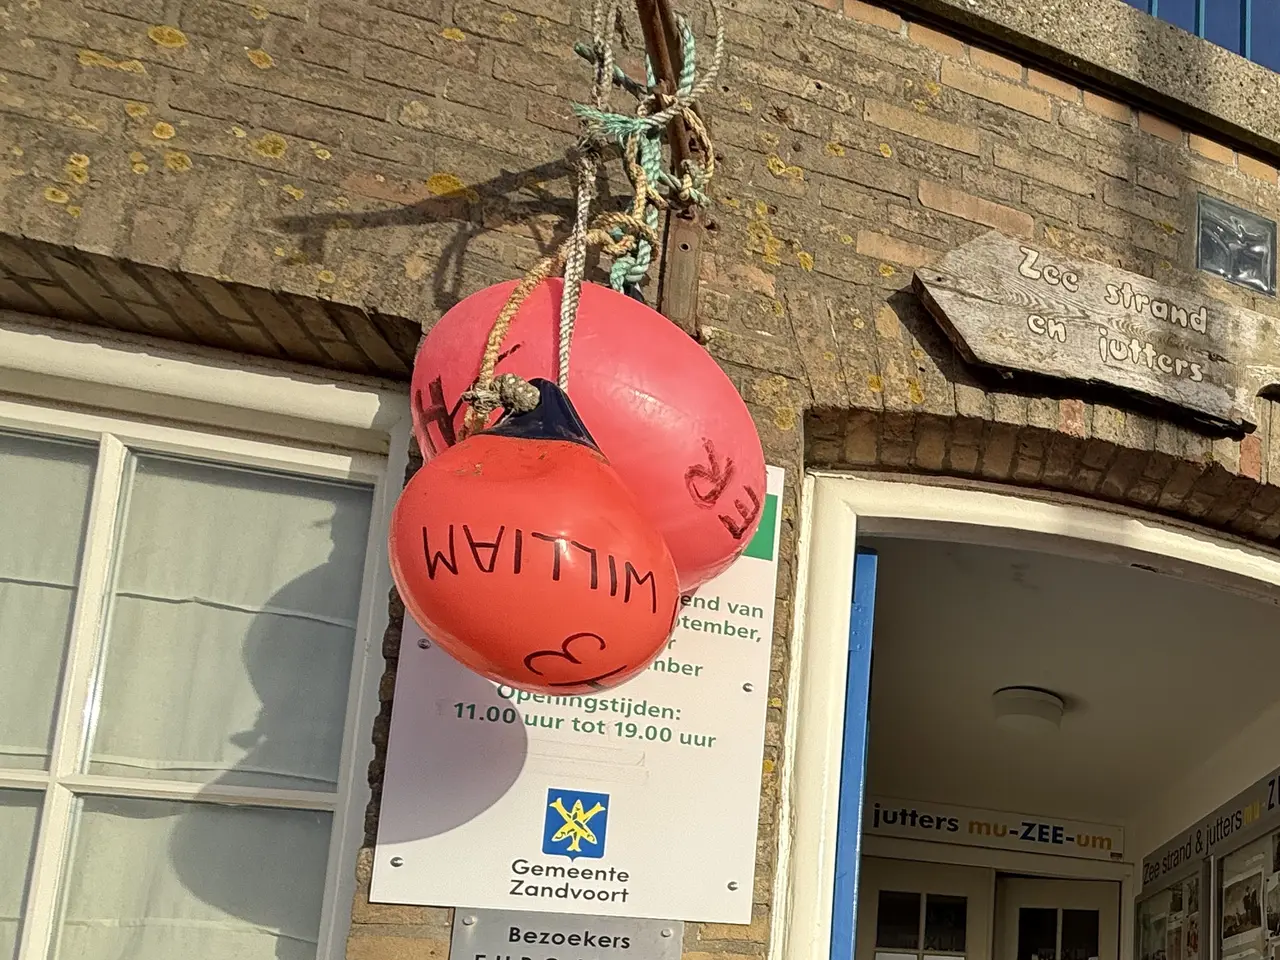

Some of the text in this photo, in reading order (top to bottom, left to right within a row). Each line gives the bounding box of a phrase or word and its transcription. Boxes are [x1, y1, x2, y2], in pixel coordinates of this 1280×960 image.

[1018, 246, 1208, 335] Zee strand
[1027, 314, 1067, 343] en
[423, 524, 657, 614] WILLIAM
[727, 601, 764, 618] van
[677, 615, 762, 642] tember,
[454, 702, 716, 748] 11.00 uur tot 19.00 uur
[873, 803, 1112, 850] jutters mu-ZEE-um
[1143, 860, 1161, 885] Zee
[1162, 834, 1193, 874] strand
[1195, 829, 1204, 854] &
[1206, 810, 1242, 855] jutters
[511, 859, 630, 882] Gemeente
[509, 879, 629, 902] Zandvoort
[508, 926, 631, 949] Bezoekers
